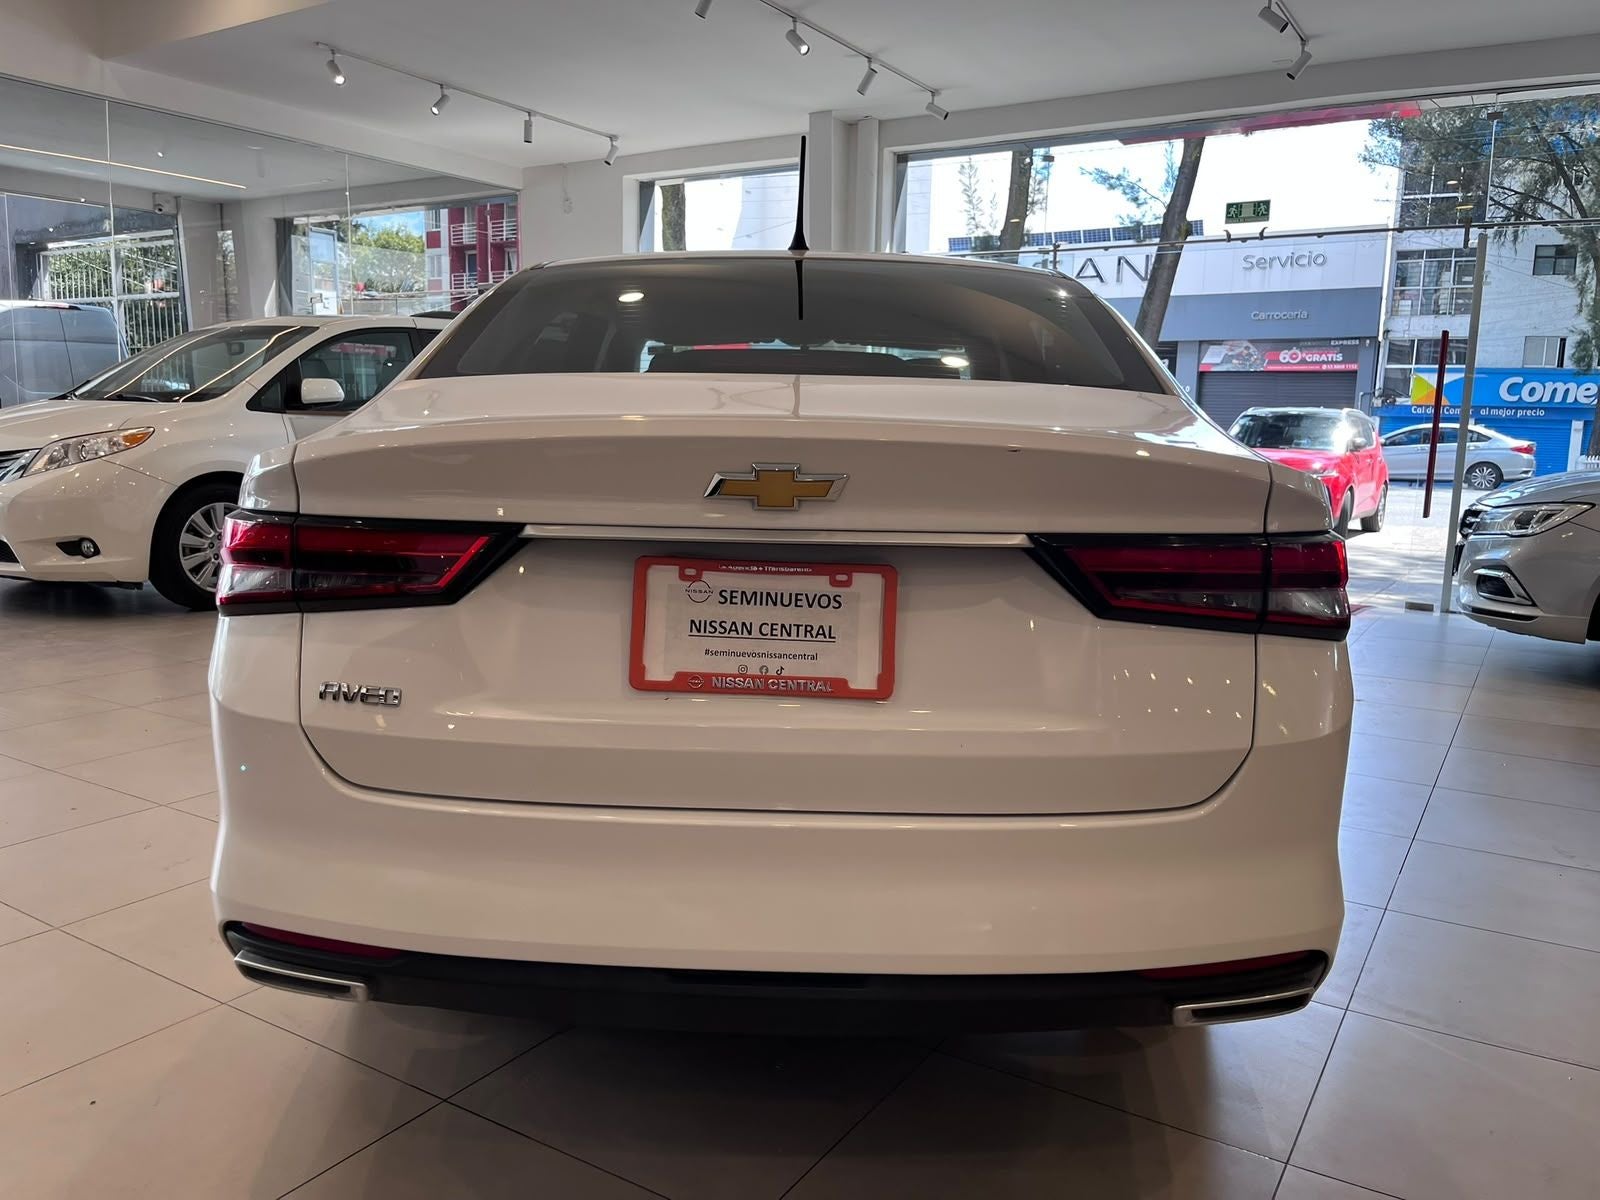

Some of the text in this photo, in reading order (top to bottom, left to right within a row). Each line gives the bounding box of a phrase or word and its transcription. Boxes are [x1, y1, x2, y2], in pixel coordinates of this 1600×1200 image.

[1242, 250, 1327, 271] Servicio
[1499, 376, 1599, 406] Come
[1480, 407, 1489, 416] al
[1490, 407, 1515, 418] mejor
[1516, 408, 1545, 418] precio
[718, 589, 843, 609] SEMINUEVOS
[689, 619, 836, 640] NISSAN CENTRAL
[704, 648, 818, 661] #seminuevosnissancentral
[318, 681, 402, 707] AVEO
[711, 676, 834, 692] NISSAN CENTRAL
